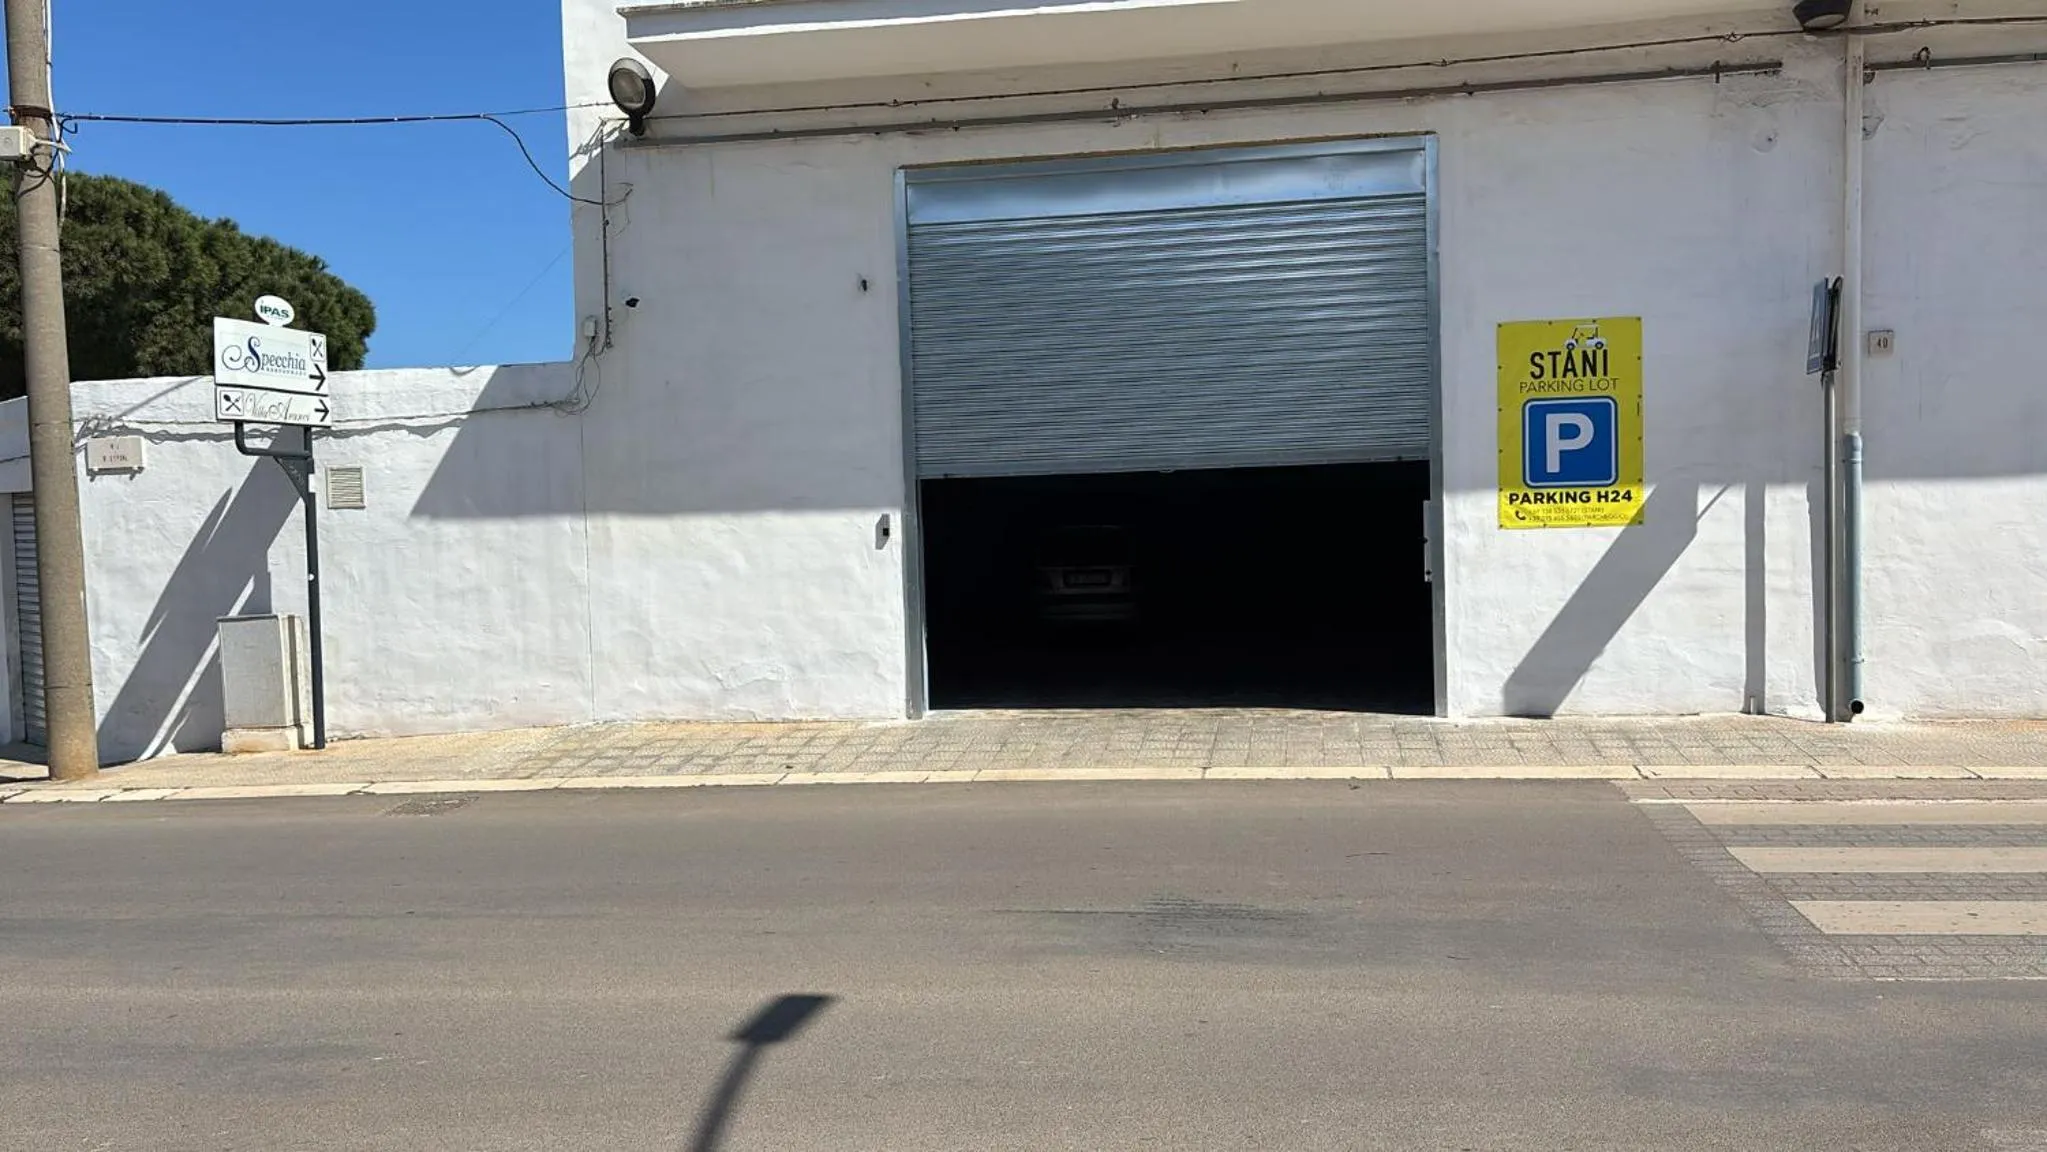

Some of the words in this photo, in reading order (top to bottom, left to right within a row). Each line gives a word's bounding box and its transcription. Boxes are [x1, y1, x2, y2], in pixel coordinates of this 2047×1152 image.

[222, 336, 306, 374] Specchia
[1530, 348, 1609, 380] STANI
[1519, 378, 1584, 394] PARKING
[1589, 377, 1620, 392] LOT
[1545, 412, 1595, 474] P
[1508, 491, 1592, 506] PARKING
[1597, 489, 1633, 504] H24
